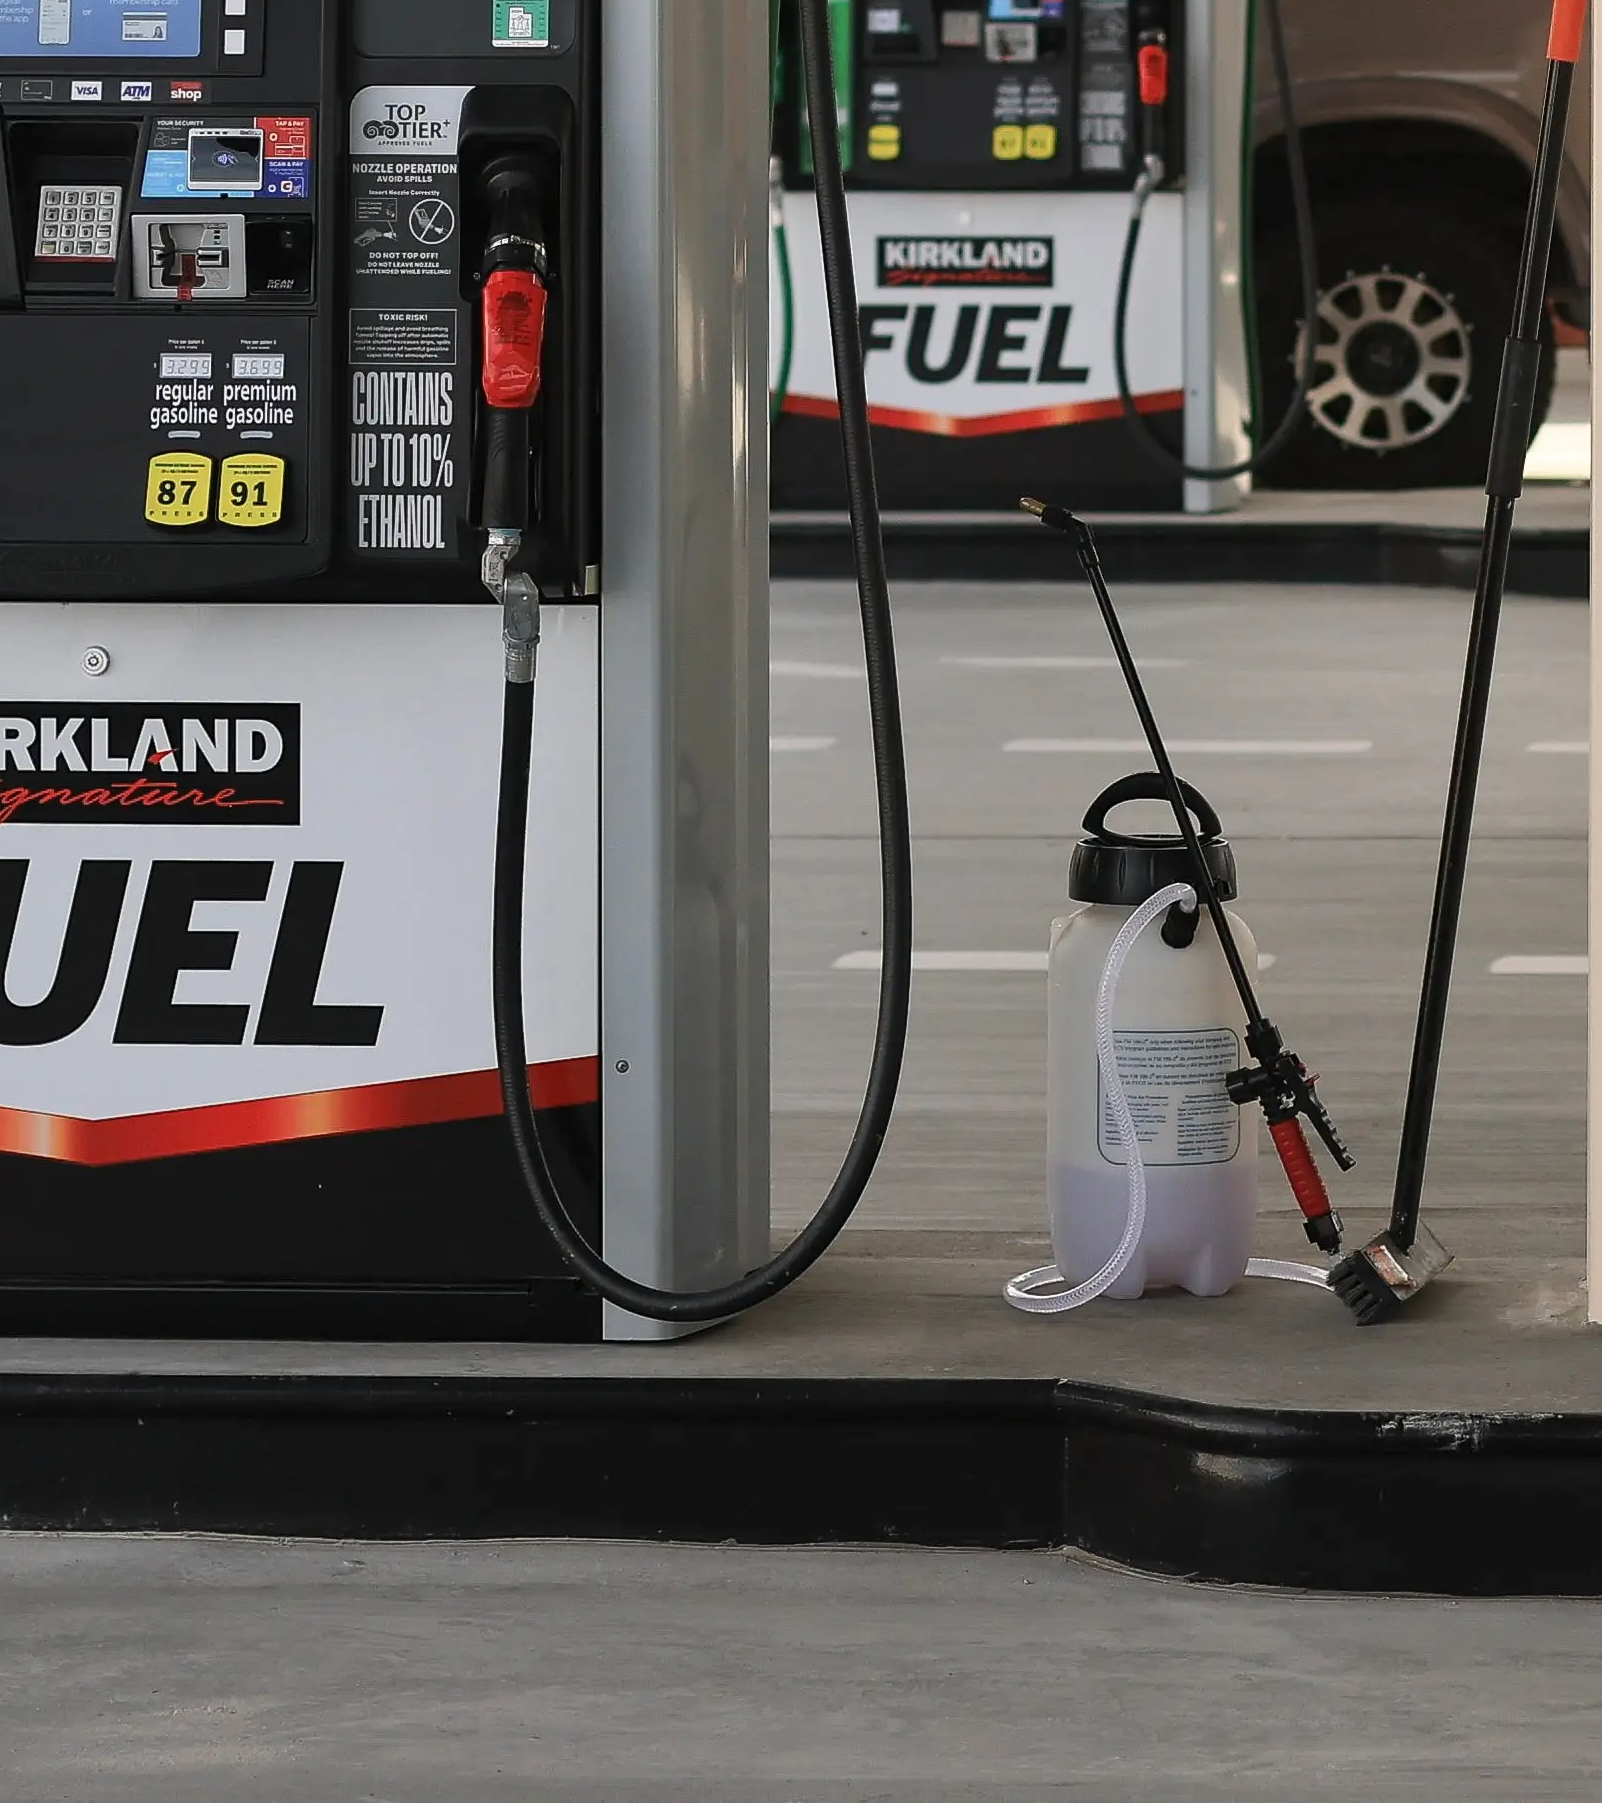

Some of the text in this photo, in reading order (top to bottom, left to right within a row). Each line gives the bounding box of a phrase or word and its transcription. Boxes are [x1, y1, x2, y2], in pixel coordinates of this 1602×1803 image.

[75, 85, 99, 95] VISA
[122, 85, 150, 97] ATM
[171, 89, 201, 101] shop
[385, 104, 426, 121] TOP
[352, 163, 458, 174] NOZZLE OPERATION
[884, 240, 1048, 268] KIRKLAND
[859, 305, 1091, 384] FUEL
[156, 378, 213, 406] regular
[224, 379, 296, 406] premium
[352, 372, 453, 425] CONTAINS
[150, 402, 218, 429] gasoline
[225, 402, 294, 429] gasoline
[351, 434, 454, 487] UP TO 10%
[157, 480, 197, 505] 87
[231, 481, 268, 506] 91
[359, 495, 445, 549] ETHANOL
